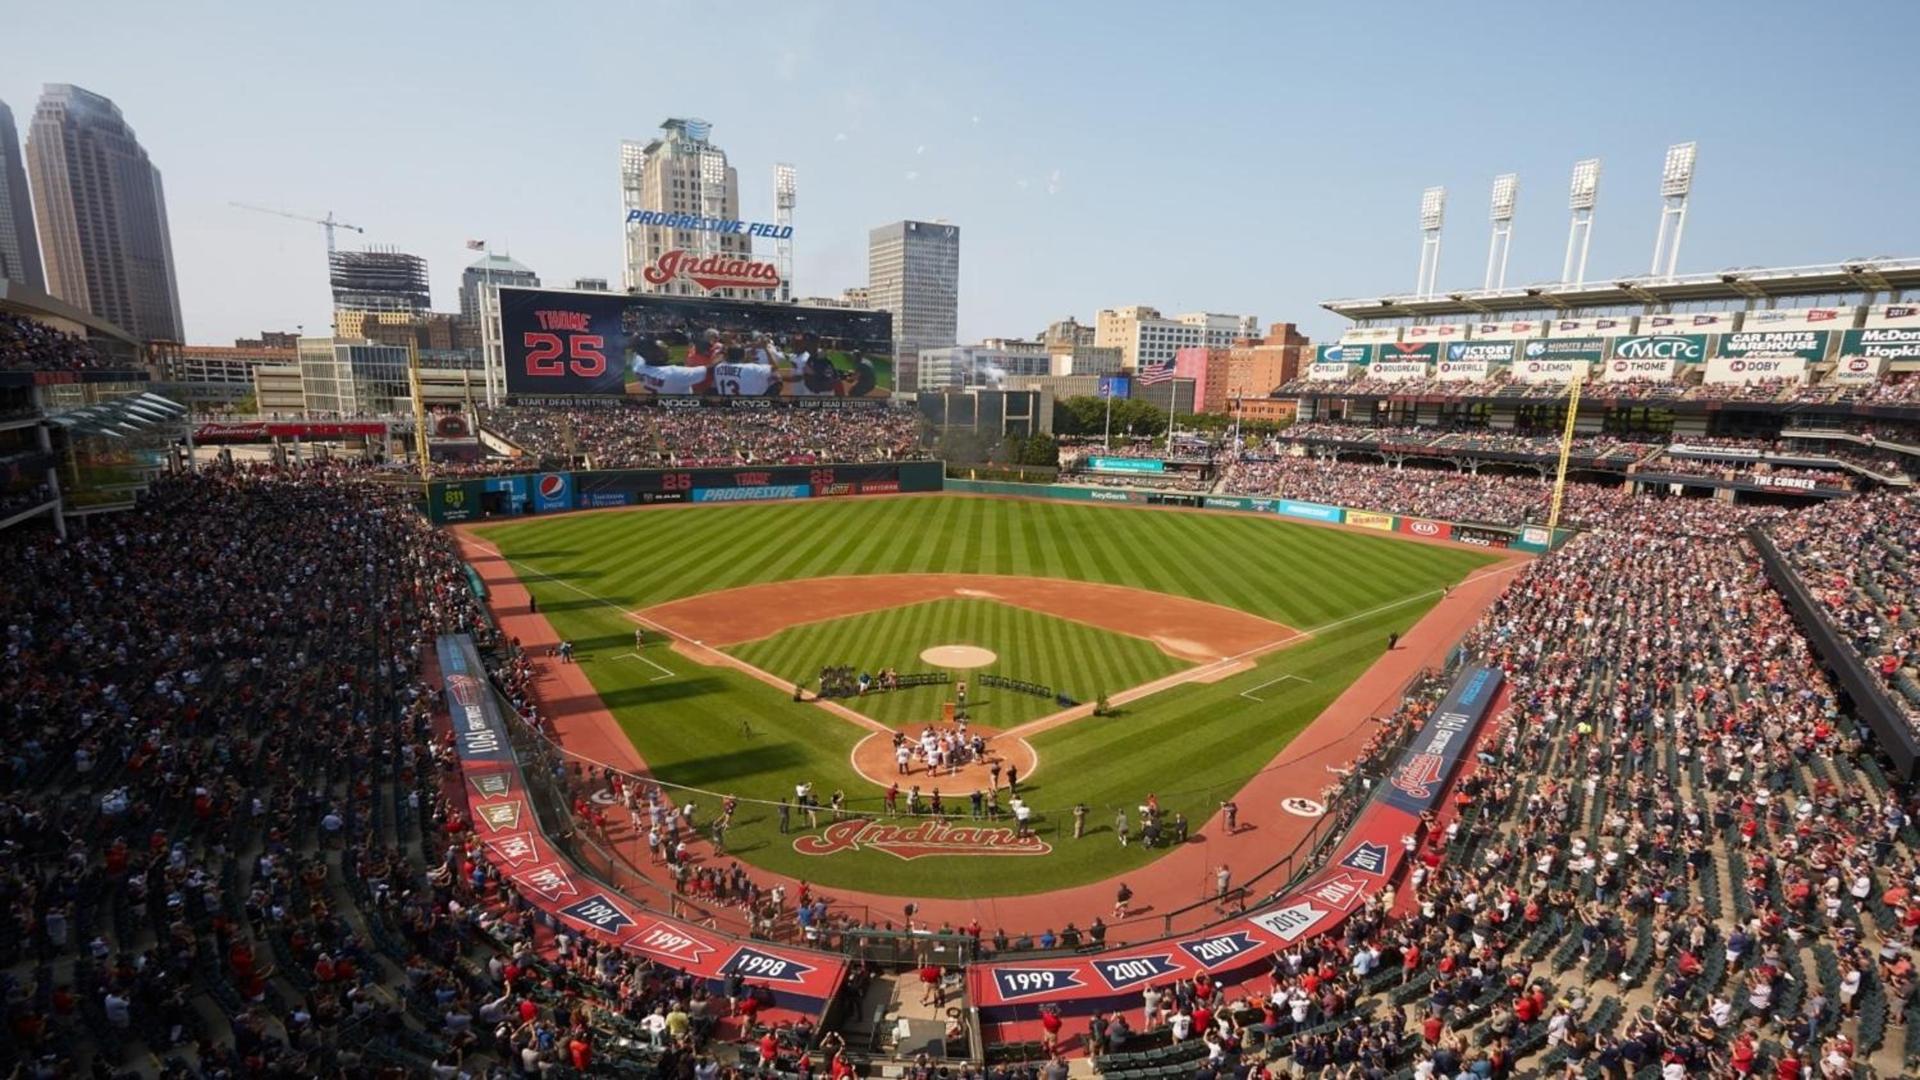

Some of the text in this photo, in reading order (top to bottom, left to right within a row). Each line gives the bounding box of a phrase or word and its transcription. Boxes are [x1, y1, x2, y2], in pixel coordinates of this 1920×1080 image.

[626, 209, 794, 240] PROGRESSIVE FIELD
[644, 249, 781, 291] Indians
[535, 310, 592, 332] THOME
[1727, 340, 1818, 351] WAREHOUSE
[1732, 331, 1815, 343] CAR PARTS
[524, 332, 606, 377] 25
[1450, 344, 1514, 358] VICTORY
[1383, 364, 1420, 373] BOUDREAU
[1451, 363, 1484, 372] AVERILL
[1541, 362, 1572, 372] LEMON
[1630, 361, 1667, 371] THOME
[1747, 361, 1781, 371] DOBY
[719, 379, 740, 396] 13
[657, 399, 700, 408] NOCO
[662, 473, 692, 490] 25
[1754, 475, 1774, 485] THE
[1774, 477, 1817, 490] CORNER
[702, 486, 799, 501] PROGRESSIVE
[1091, 491, 1127, 501] KeyBank
[1415, 522, 1434, 532] KIA
[1460, 536, 1490, 546] NOCO
[464, 729, 499, 754] 1901
[792, 818, 1052, 861] Indians
[1352, 849, 1382, 871] 2017
[527, 868, 566, 891] 1995
[1315, 880, 1355, 904] 2016
[576, 900, 618, 924] 1996
[1265, 909, 1309, 933] 2013
[649, 929, 693, 951] 1997
[1192, 936, 1241, 961] 2007
[737, 954, 788, 977] 1998
[1105, 958, 1160, 982] 2001
[1003, 971, 1055, 992] 1999
